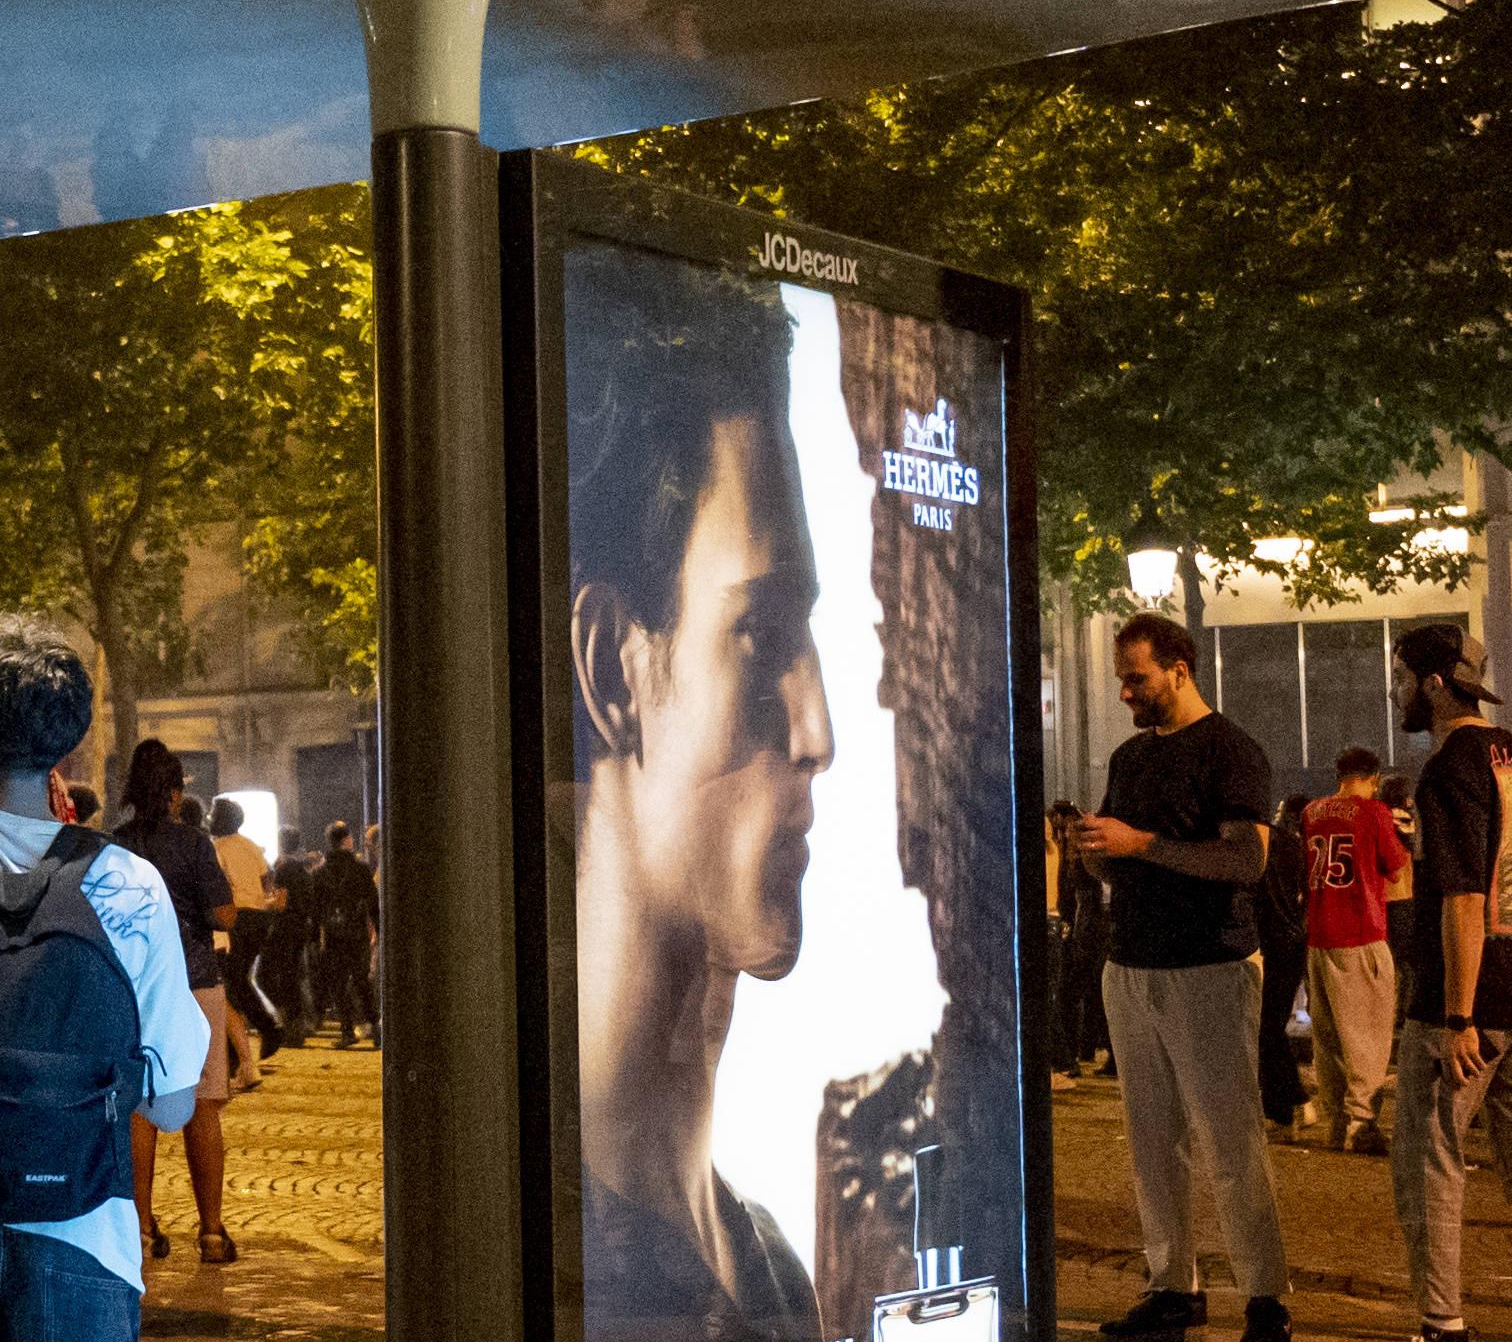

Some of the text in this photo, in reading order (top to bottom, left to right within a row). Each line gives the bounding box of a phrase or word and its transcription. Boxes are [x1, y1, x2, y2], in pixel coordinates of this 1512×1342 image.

[759, 232, 859, 285] JCDecaux
[883, 451, 979, 505] HERMÈS
[914, 504, 952, 531] PARIS
[26, 1174, 65, 1182] EASTPAK
